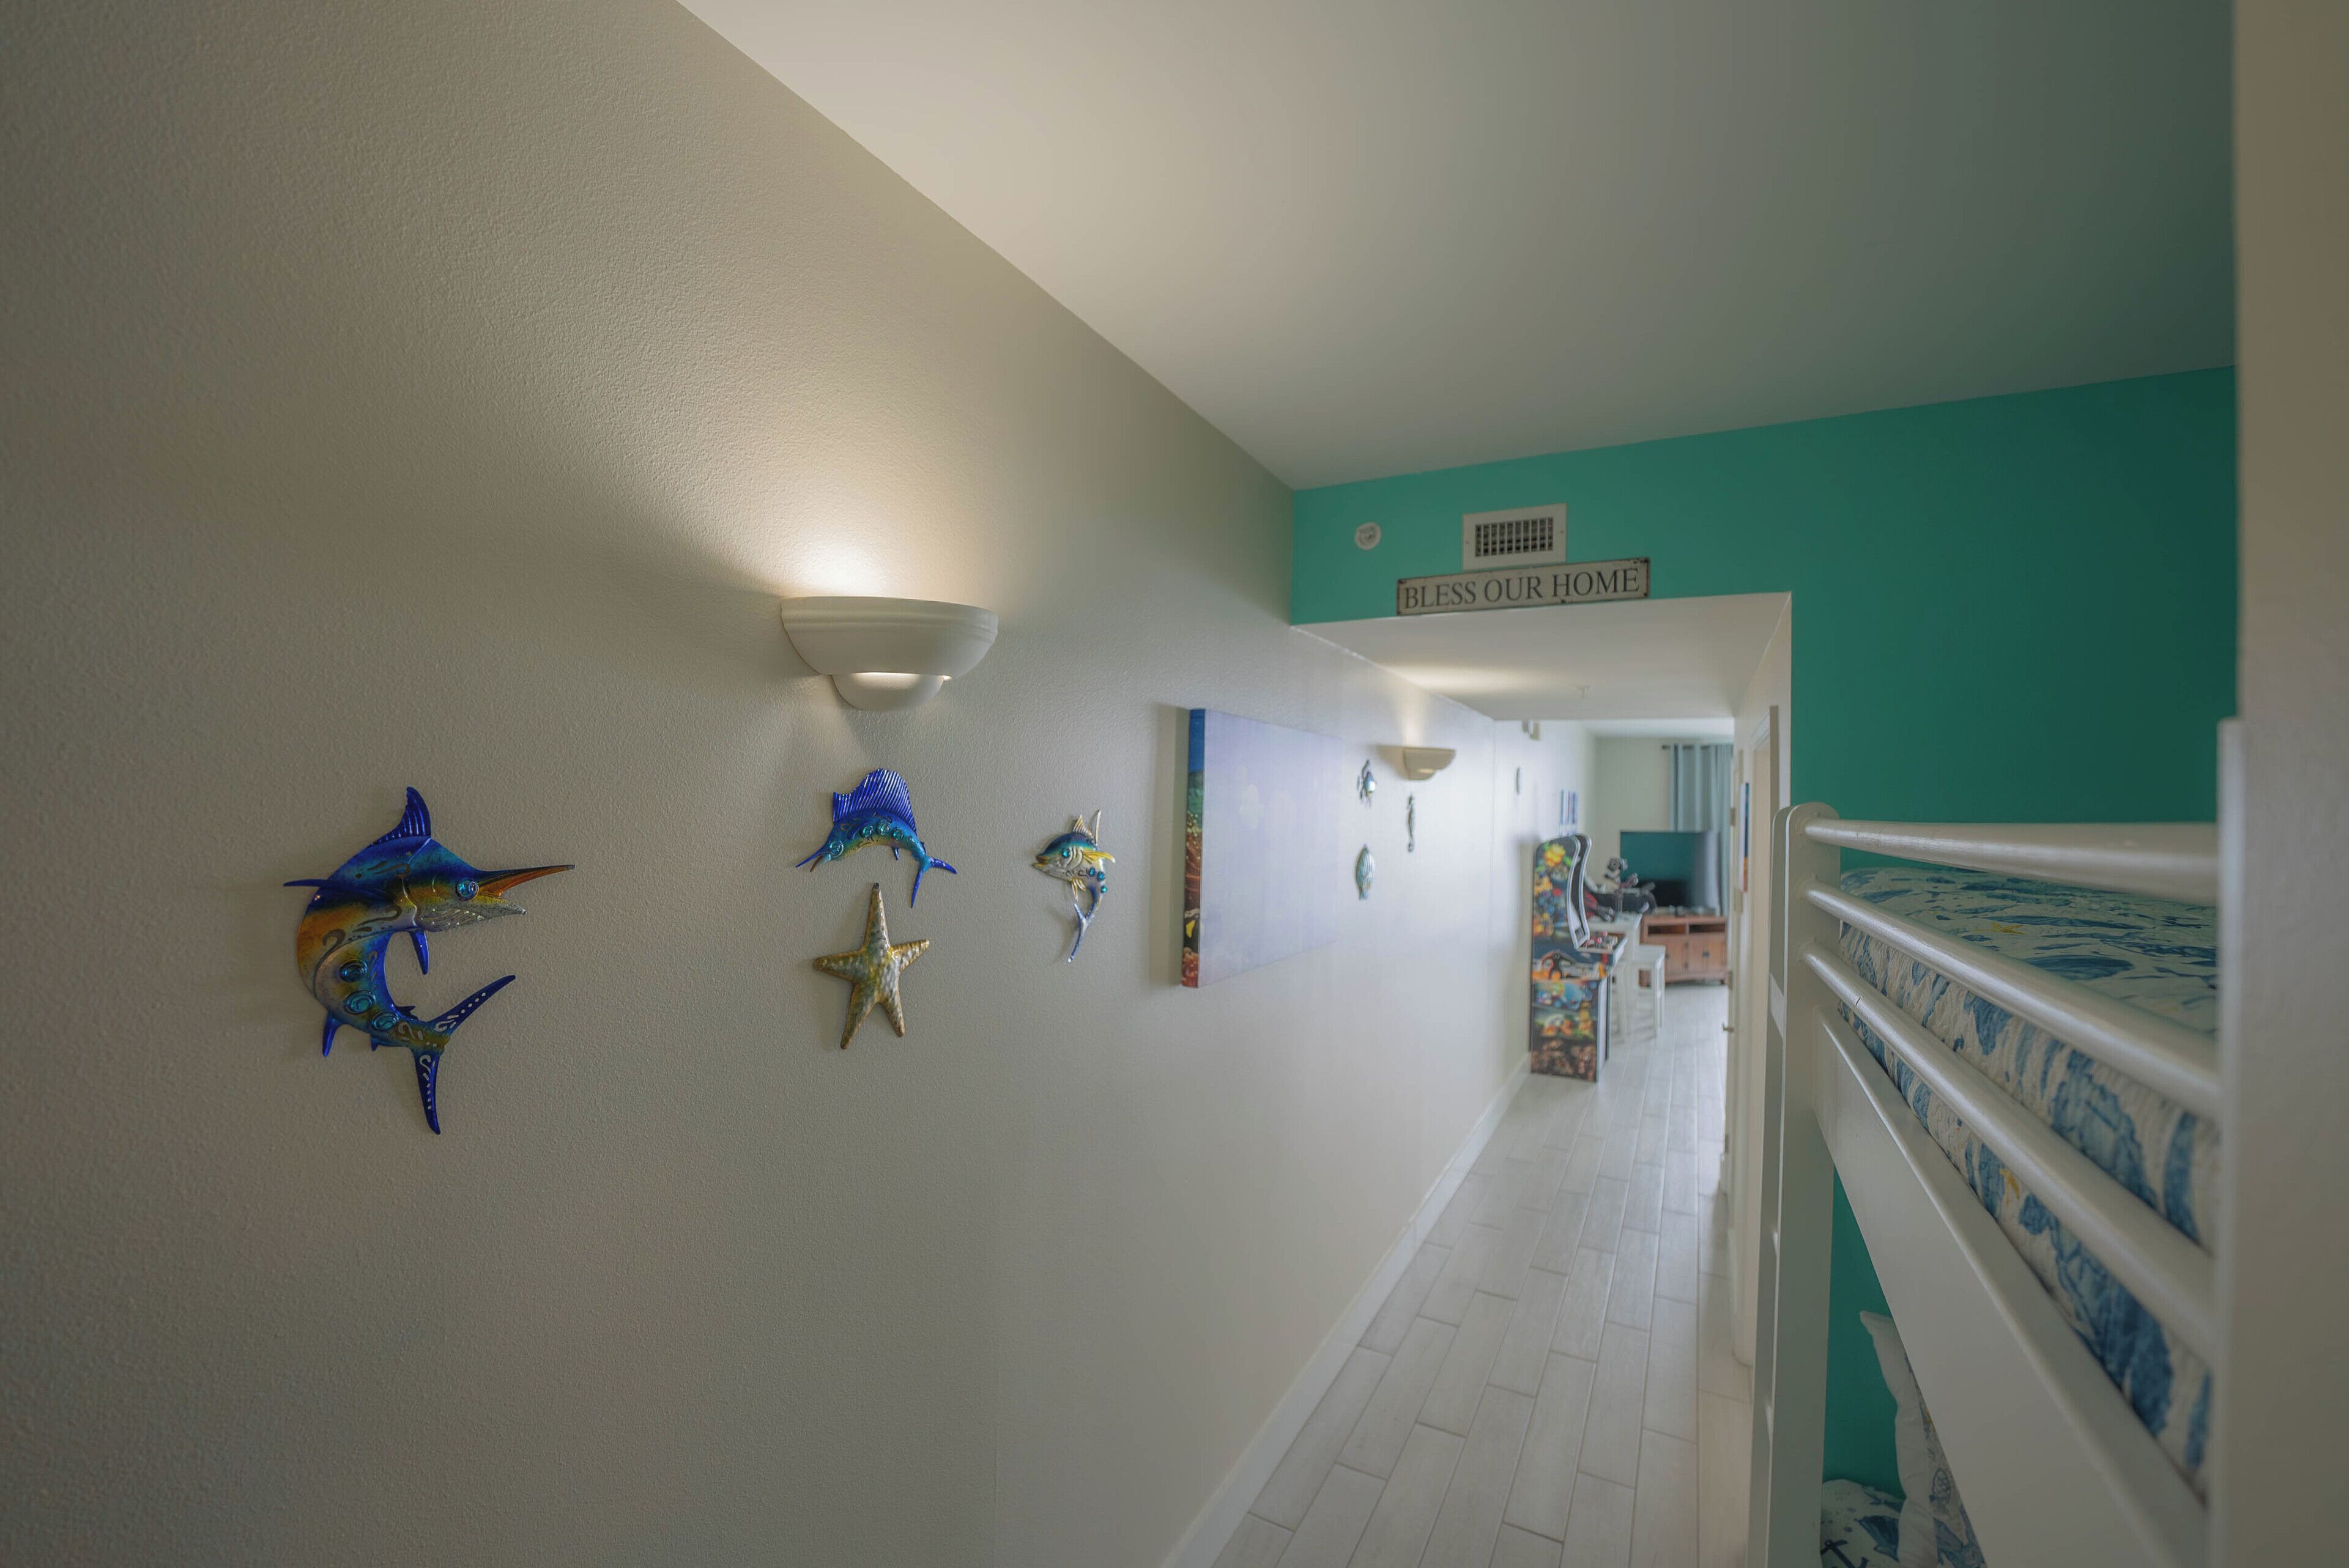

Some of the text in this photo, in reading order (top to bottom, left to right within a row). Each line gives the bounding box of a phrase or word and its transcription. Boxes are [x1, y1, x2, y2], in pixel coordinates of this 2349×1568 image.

[1406, 568, 1640, 608] BLESS OUR HOME
